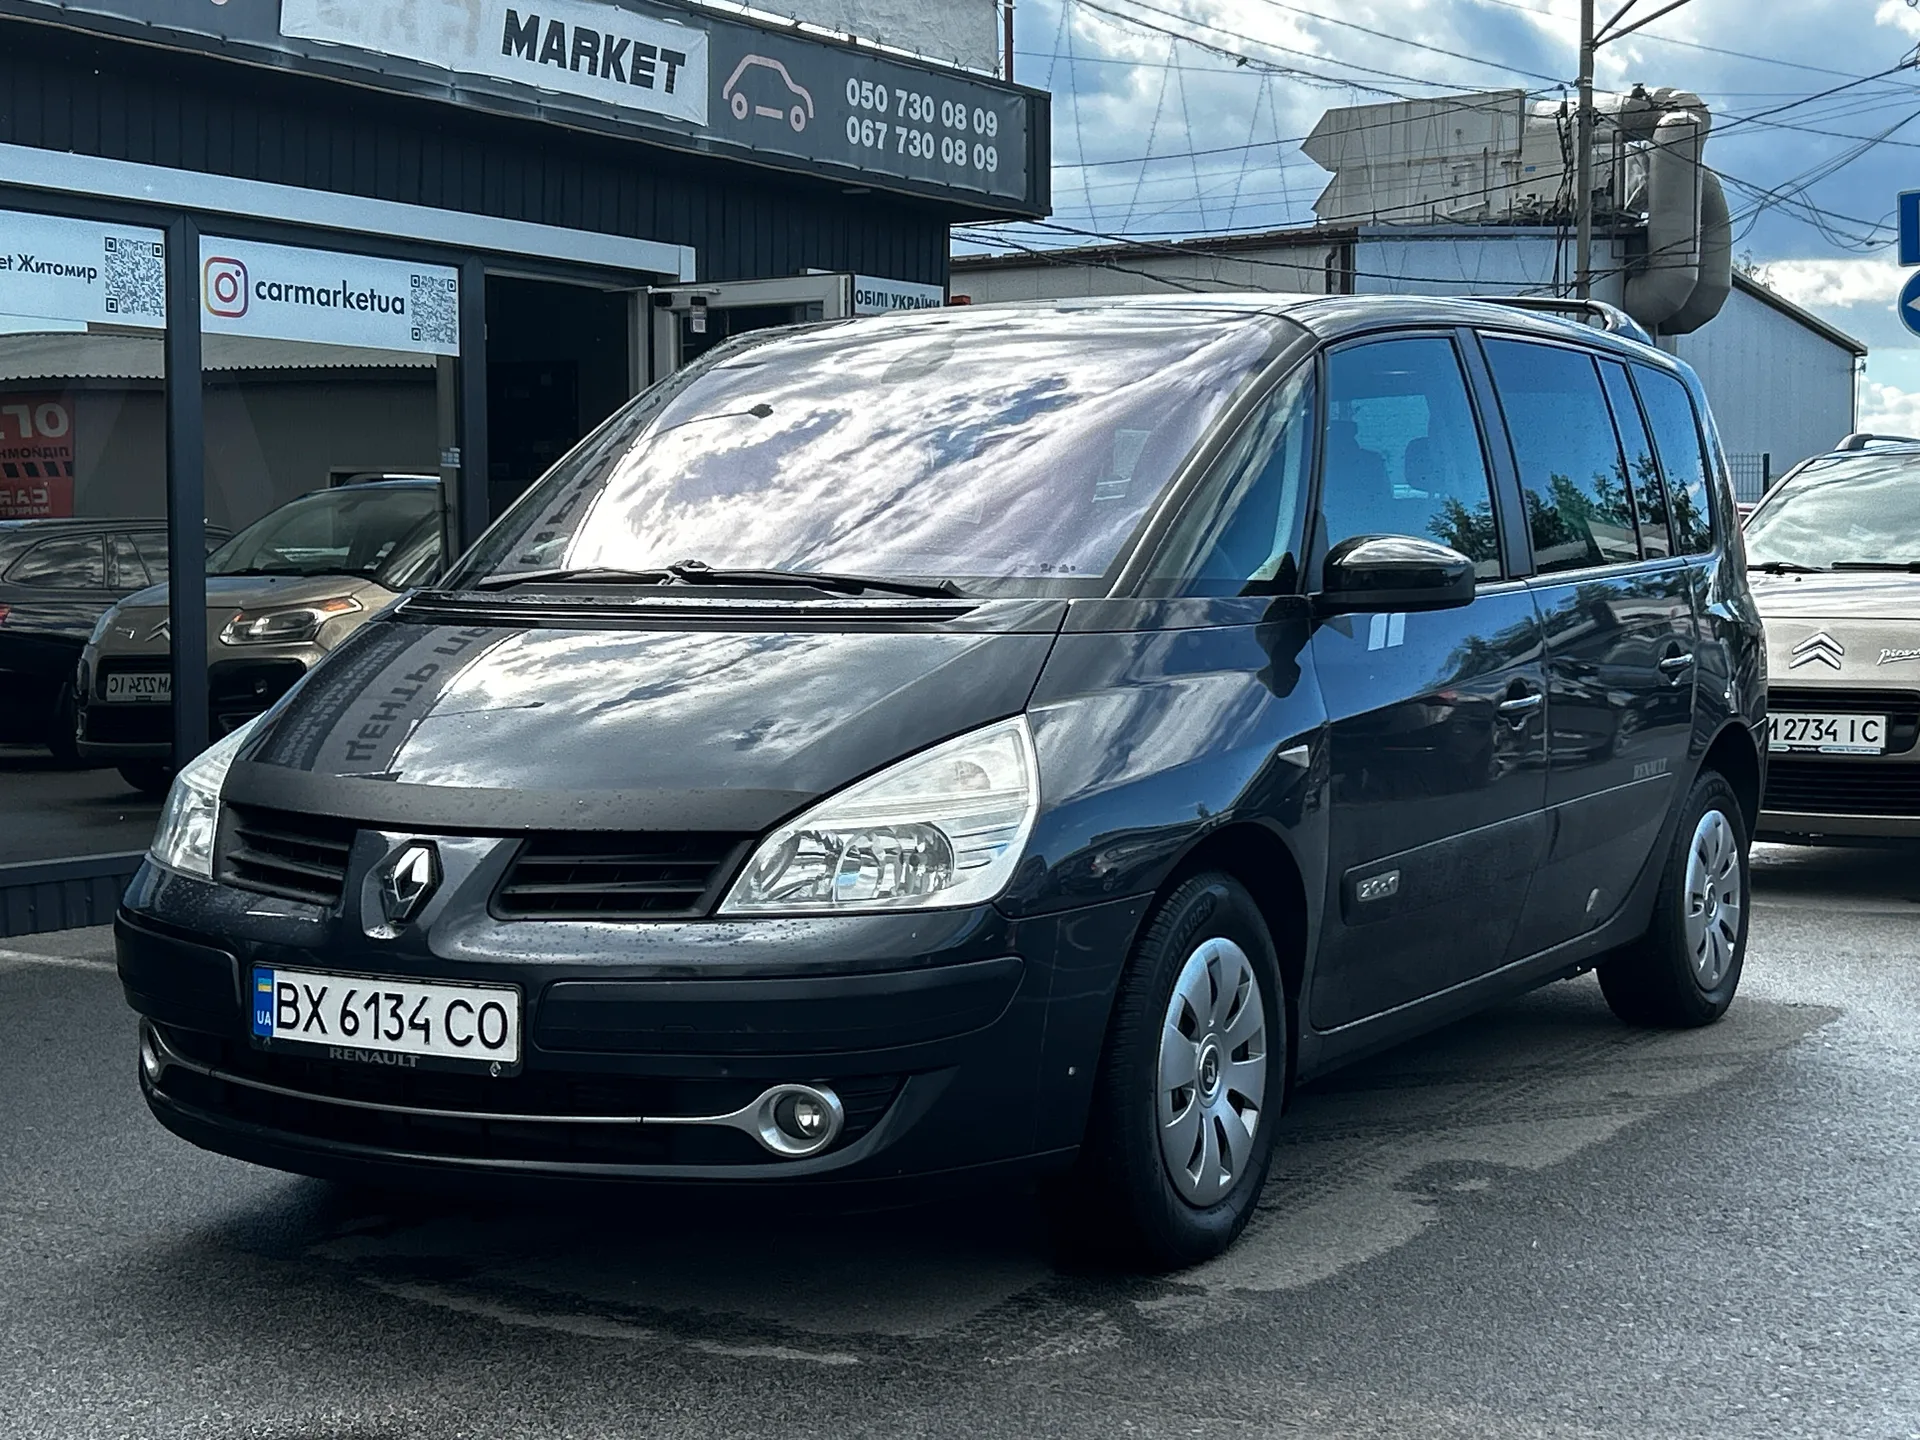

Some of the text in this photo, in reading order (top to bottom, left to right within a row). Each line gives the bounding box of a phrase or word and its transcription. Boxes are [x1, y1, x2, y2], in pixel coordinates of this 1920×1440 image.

[502, 8, 687, 95] MARKET
[846, 77, 998, 138] 050 730 08 09
[846, 115, 998, 174] 067 730 08 09
[17, 253, 97, 284] Житомир
[255, 276, 405, 317] carmarketua
[1784, 718, 1837, 742] 2734
[1850, 720, 1879, 743] IC
[257, 981, 508, 1050] UA BX 6134 CO
[329, 1047, 420, 1068] RENAULT
